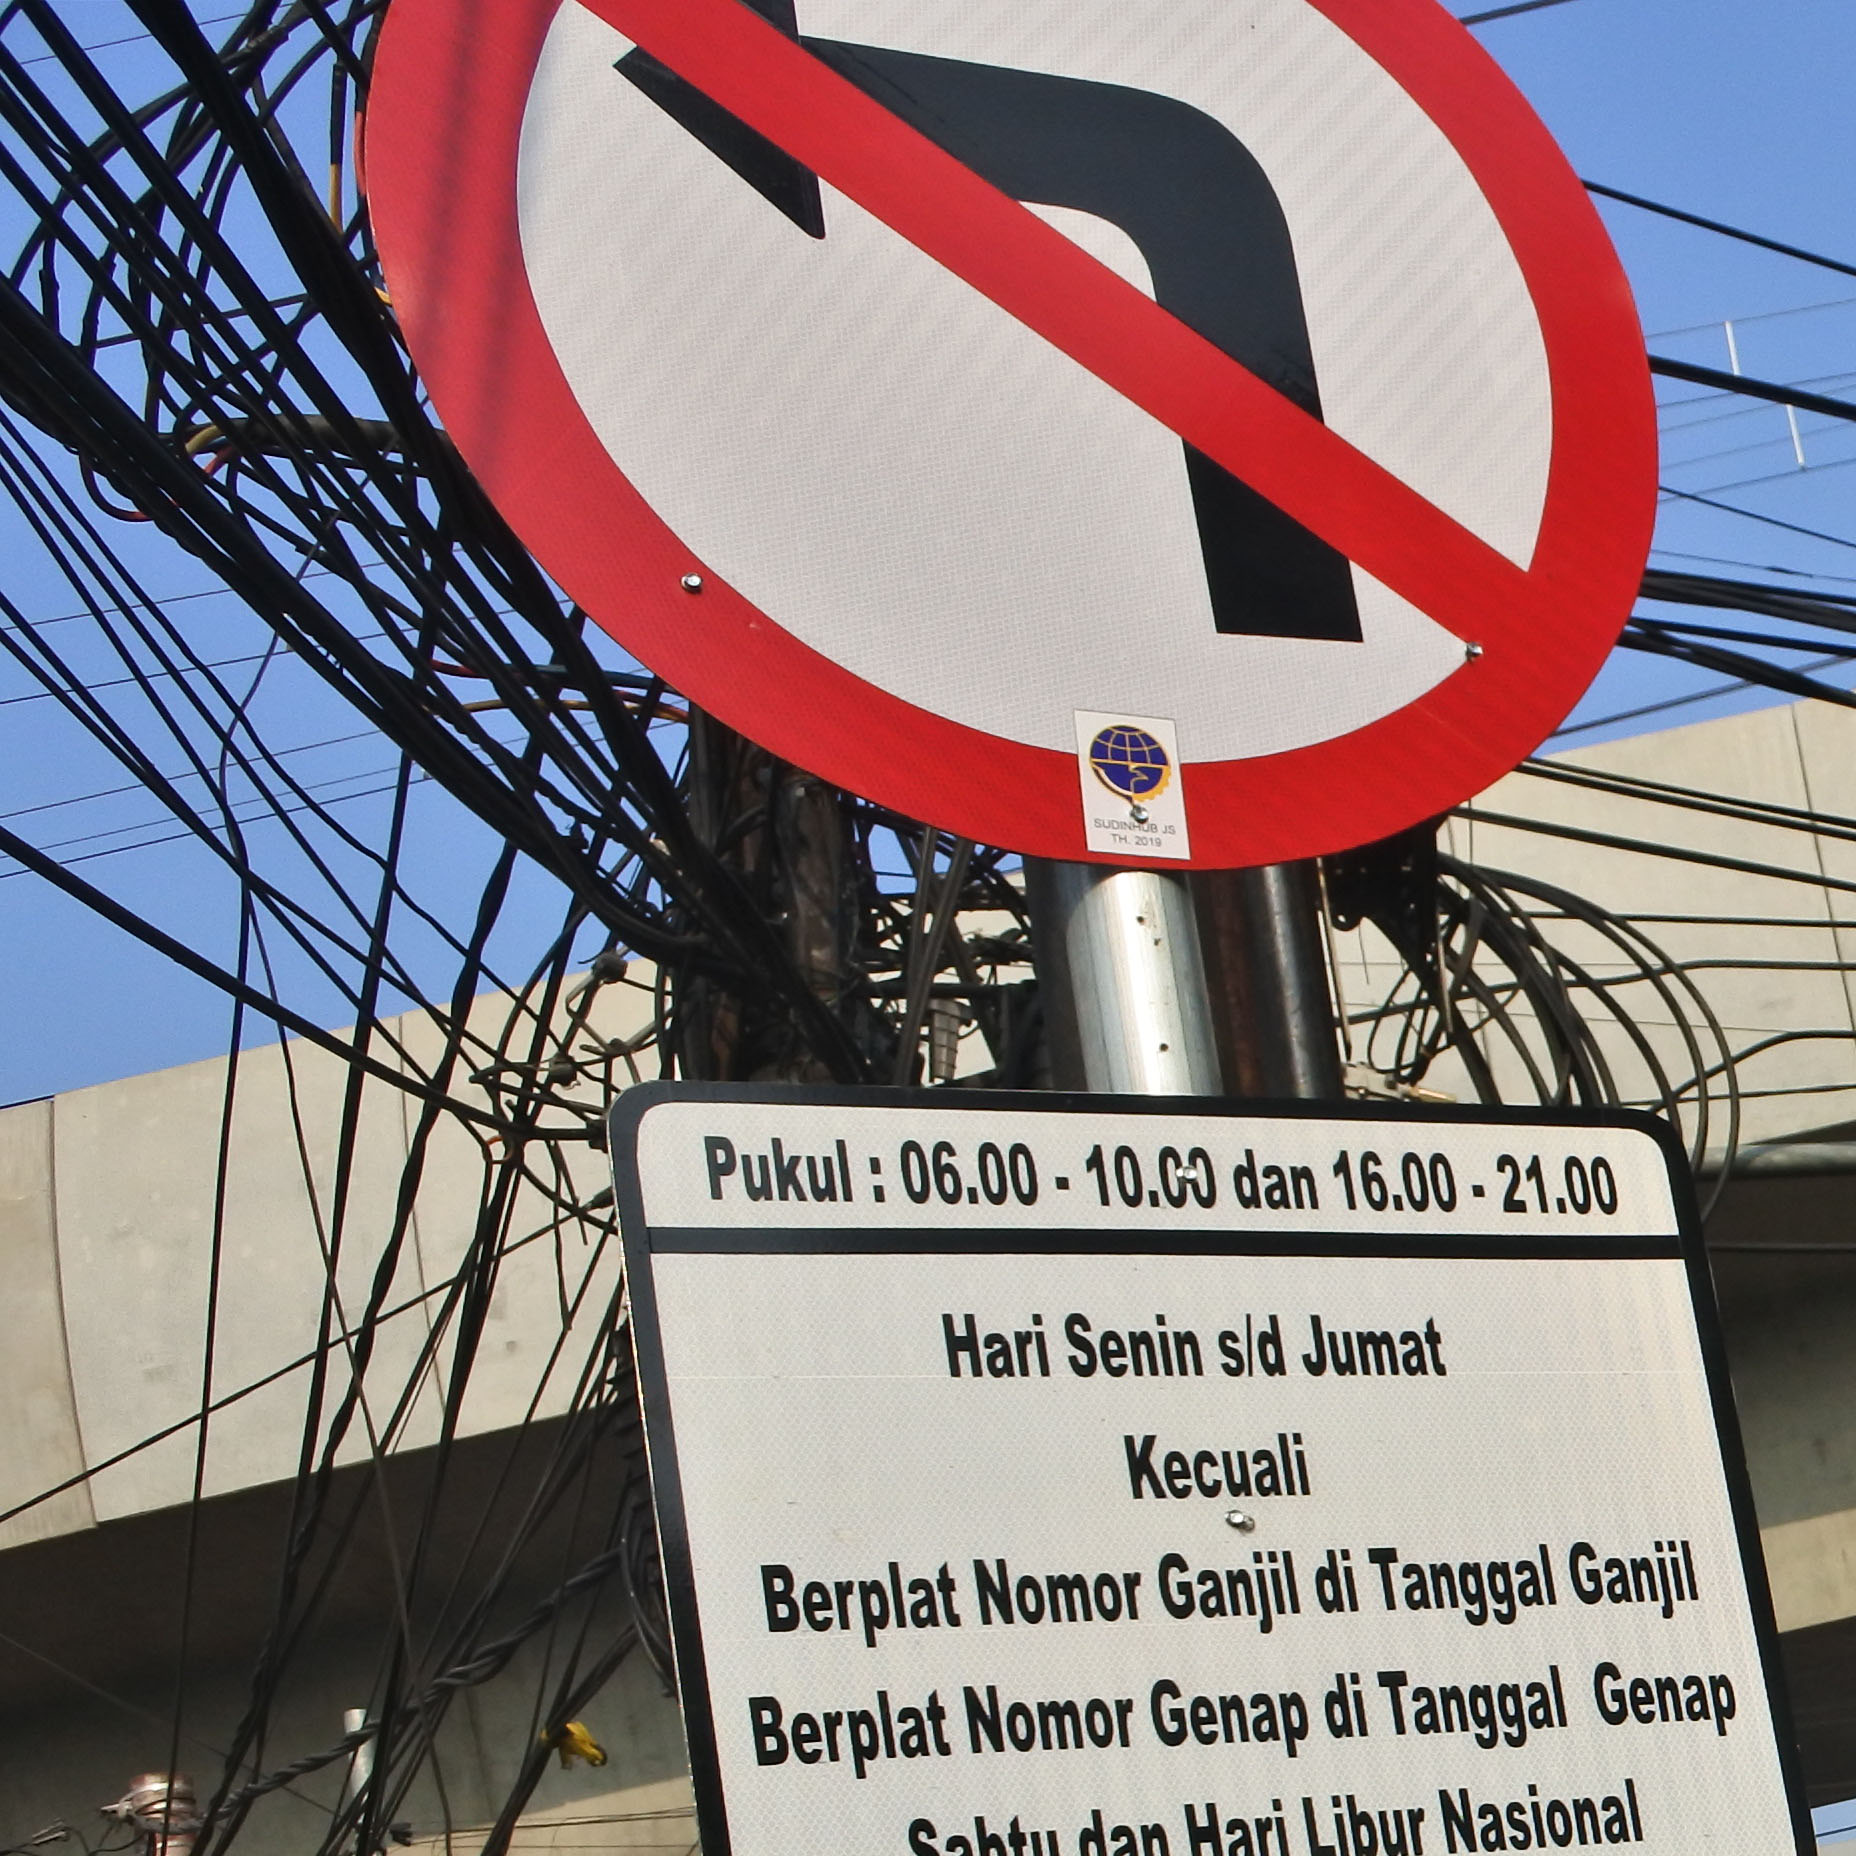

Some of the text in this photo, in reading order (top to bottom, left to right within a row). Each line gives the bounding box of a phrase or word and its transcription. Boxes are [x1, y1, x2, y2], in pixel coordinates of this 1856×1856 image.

[1094, 818, 1176, 834] SUDINHUB JS
[1111, 833, 1162, 847] TH. 2019
[704, 1136, 853, 1203] Pukul
[900, 1141, 1038, 1206] 06.00
[1086, 1144, 1217, 1209] 10.00
[1233, 1148, 1319, 1211] dan
[1332, 1150, 1457, 1213] 16.00
[1496, 1154, 1618, 1216] 21.00
[942, 1312, 1447, 1378] Hari Senin s/d Jumat
[1123, 1432, 1312, 1500] Kecuali
[760, 1540, 1699, 1648] Berplat Nomor Ganjil di Tanggal Ganjil
[748, 1661, 1737, 1780] Berplat Nomor Genap di Tanggal Genap
[1438, 1778, 1644, 1854] Nasional
